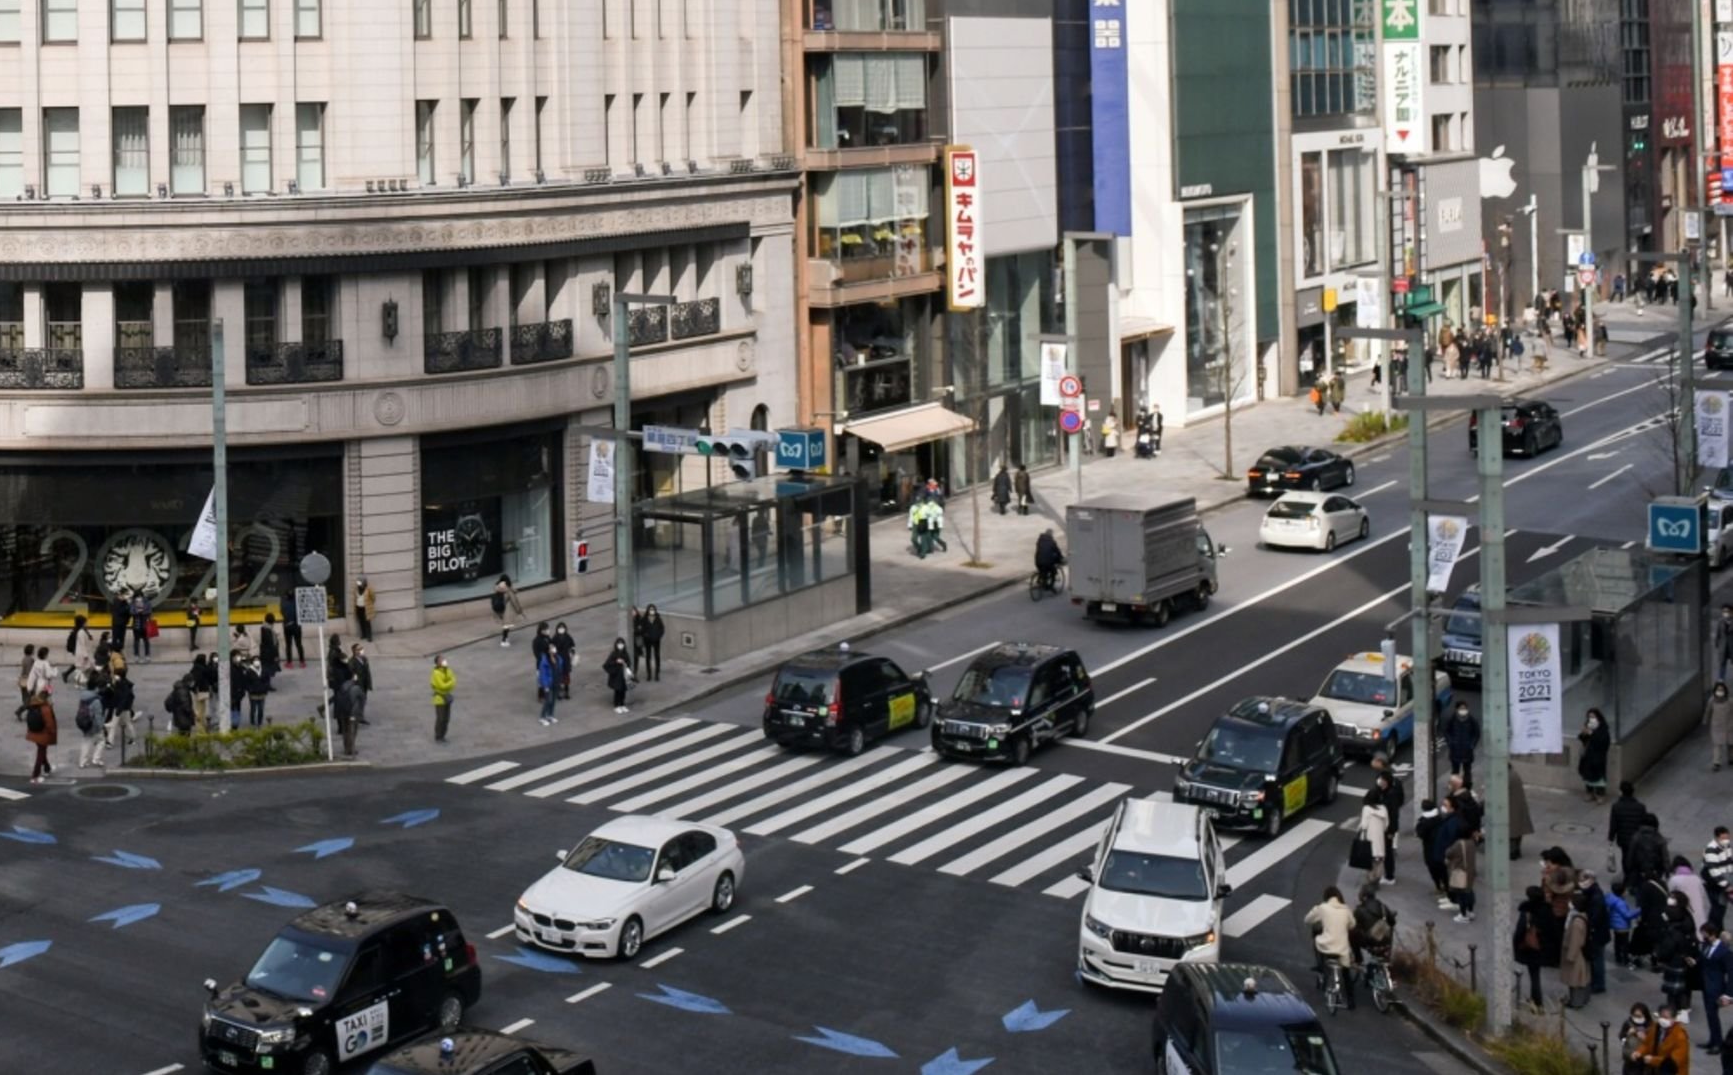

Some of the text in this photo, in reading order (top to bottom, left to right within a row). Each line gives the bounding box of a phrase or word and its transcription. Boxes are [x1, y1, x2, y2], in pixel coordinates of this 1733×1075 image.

[957, 192, 979, 299] キムラヤのパン
[428, 529, 455, 545] THE
[428, 544, 451, 559] BIG
[1518, 668, 1552, 680] TOKYO
[1518, 684, 1552, 699] 2021
[343, 1013, 368, 1034] TAXI
[345, 1030, 368, 1054] GO
